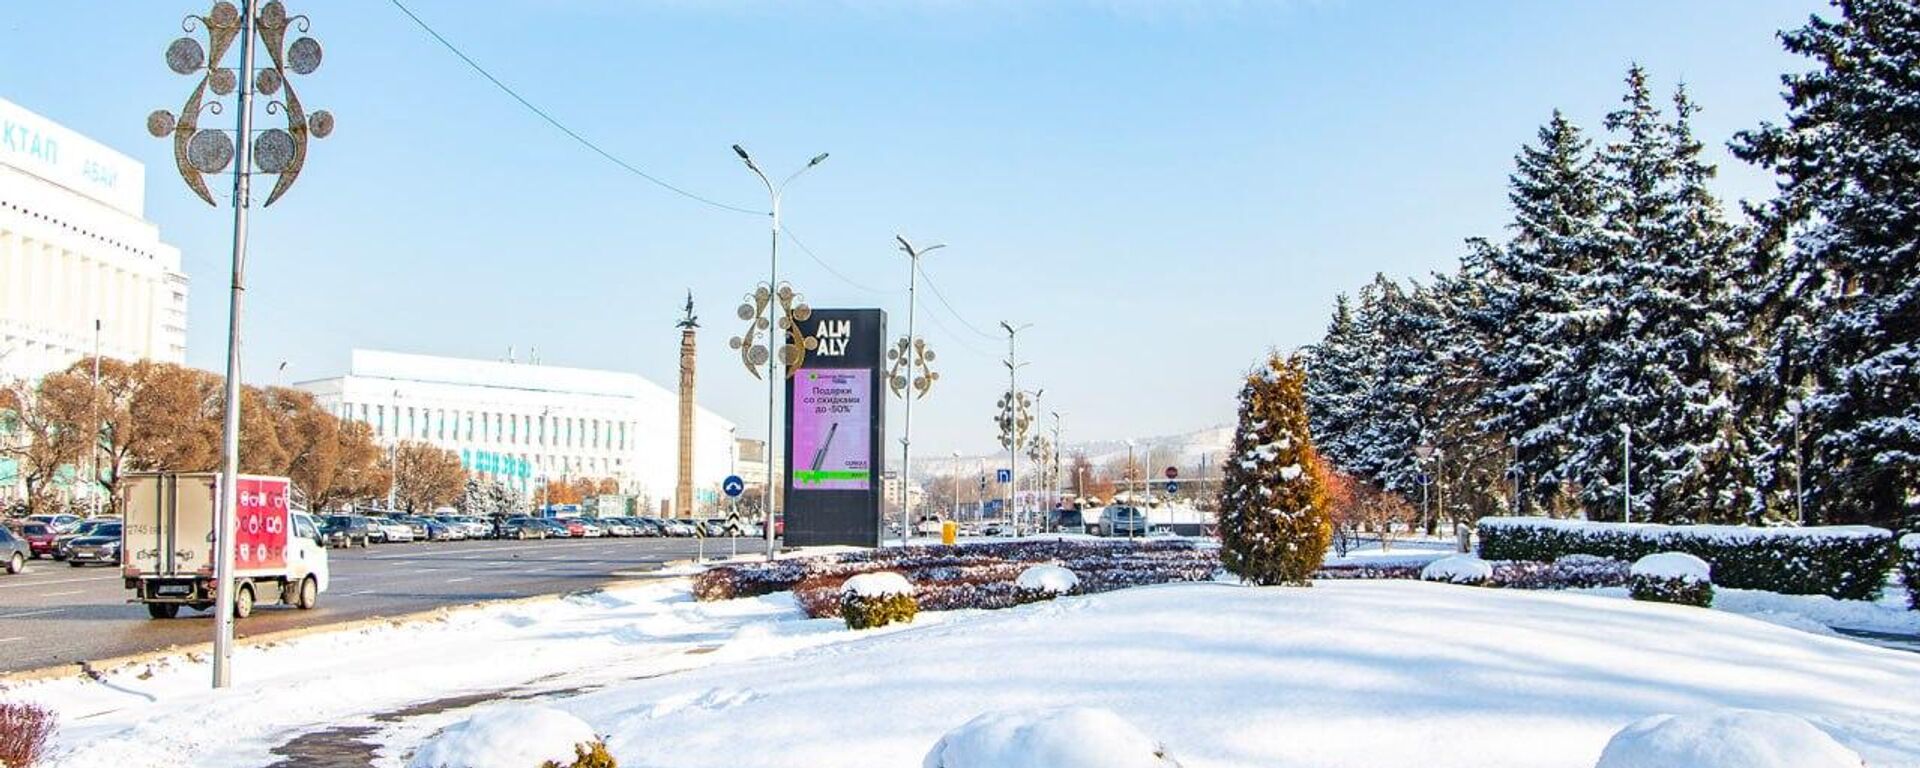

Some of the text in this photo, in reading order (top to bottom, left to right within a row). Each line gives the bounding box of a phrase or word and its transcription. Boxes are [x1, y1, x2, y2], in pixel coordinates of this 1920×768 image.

[816, 320, 850, 338] ALM
[816, 339, 849, 356] ALY
[812, 387, 852, 395] Подарки
[816, 397, 860, 405] скидками
[815, 406, 827, 414] до
